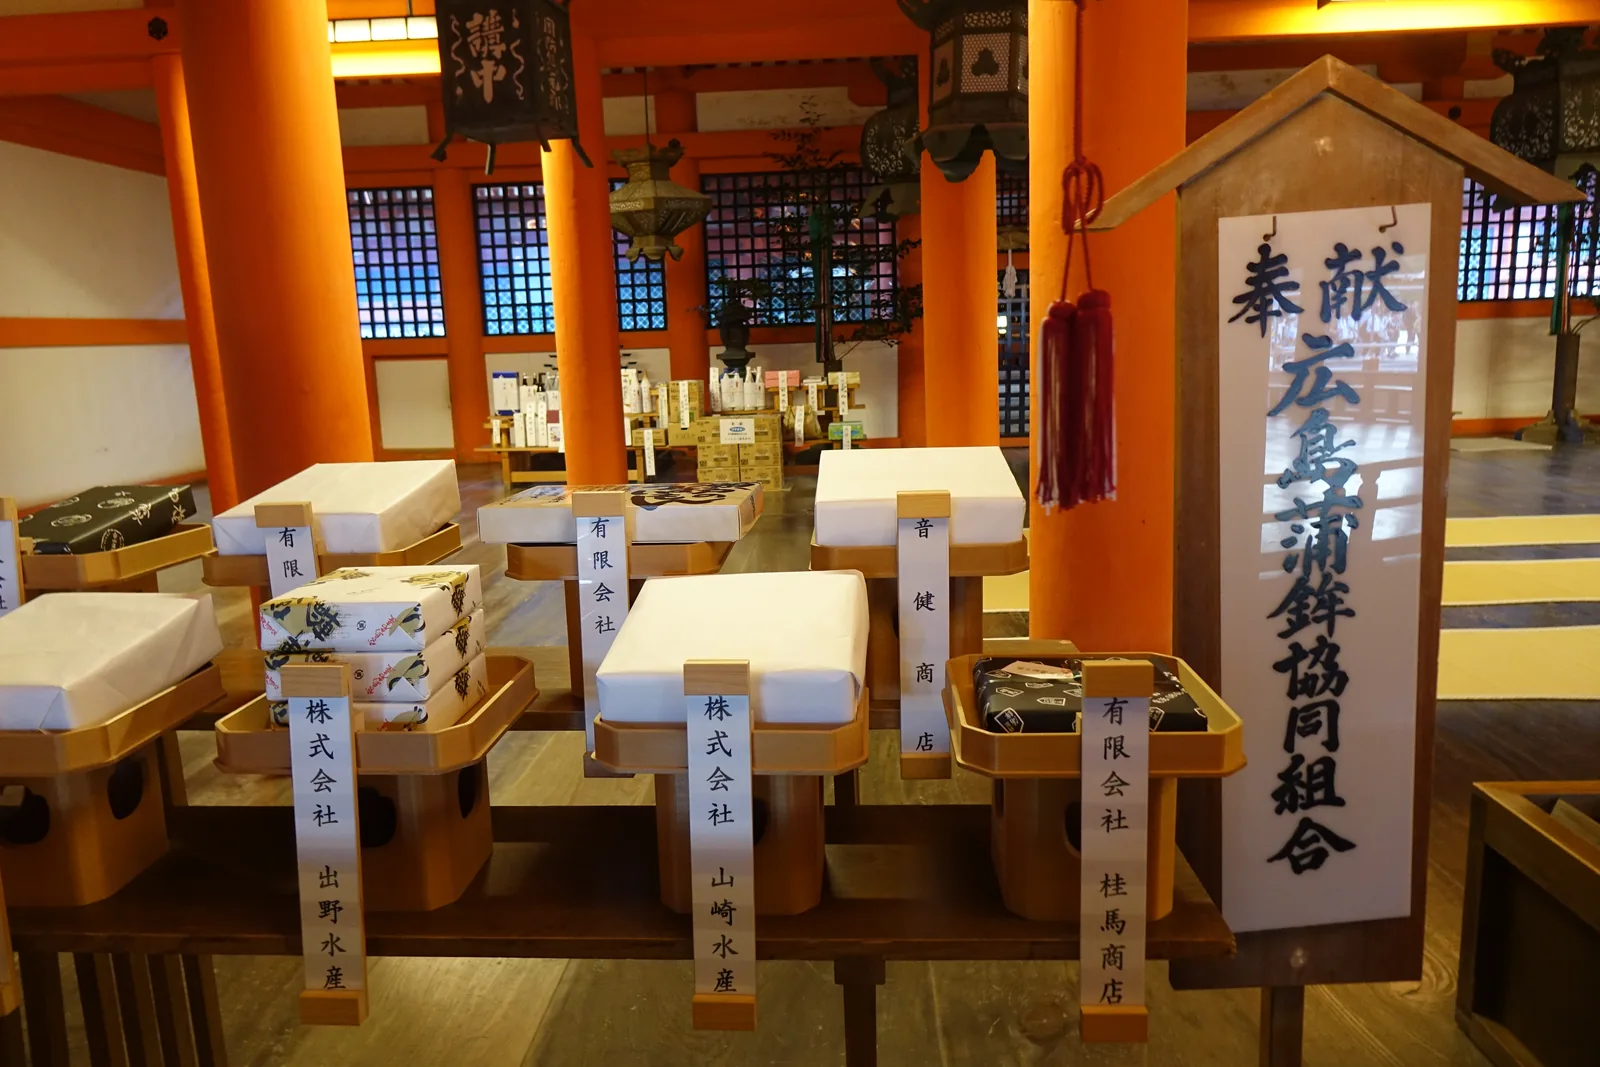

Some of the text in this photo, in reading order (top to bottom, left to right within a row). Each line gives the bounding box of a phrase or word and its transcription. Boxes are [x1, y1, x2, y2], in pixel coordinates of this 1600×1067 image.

[278, 527, 304, 578] 有限
[591, 517, 617, 635] 有限会社
[913, 517, 937, 752] 音健商店
[1266, 333, 1362, 876] 広島蒲鉾協同組合
[305, 698, 346, 989] 株式会社 出野水産
[704, 695, 739, 993] 株式会社 山崎水産
[1100, 697, 1131, 1006] 有限会社 桂馬商店
